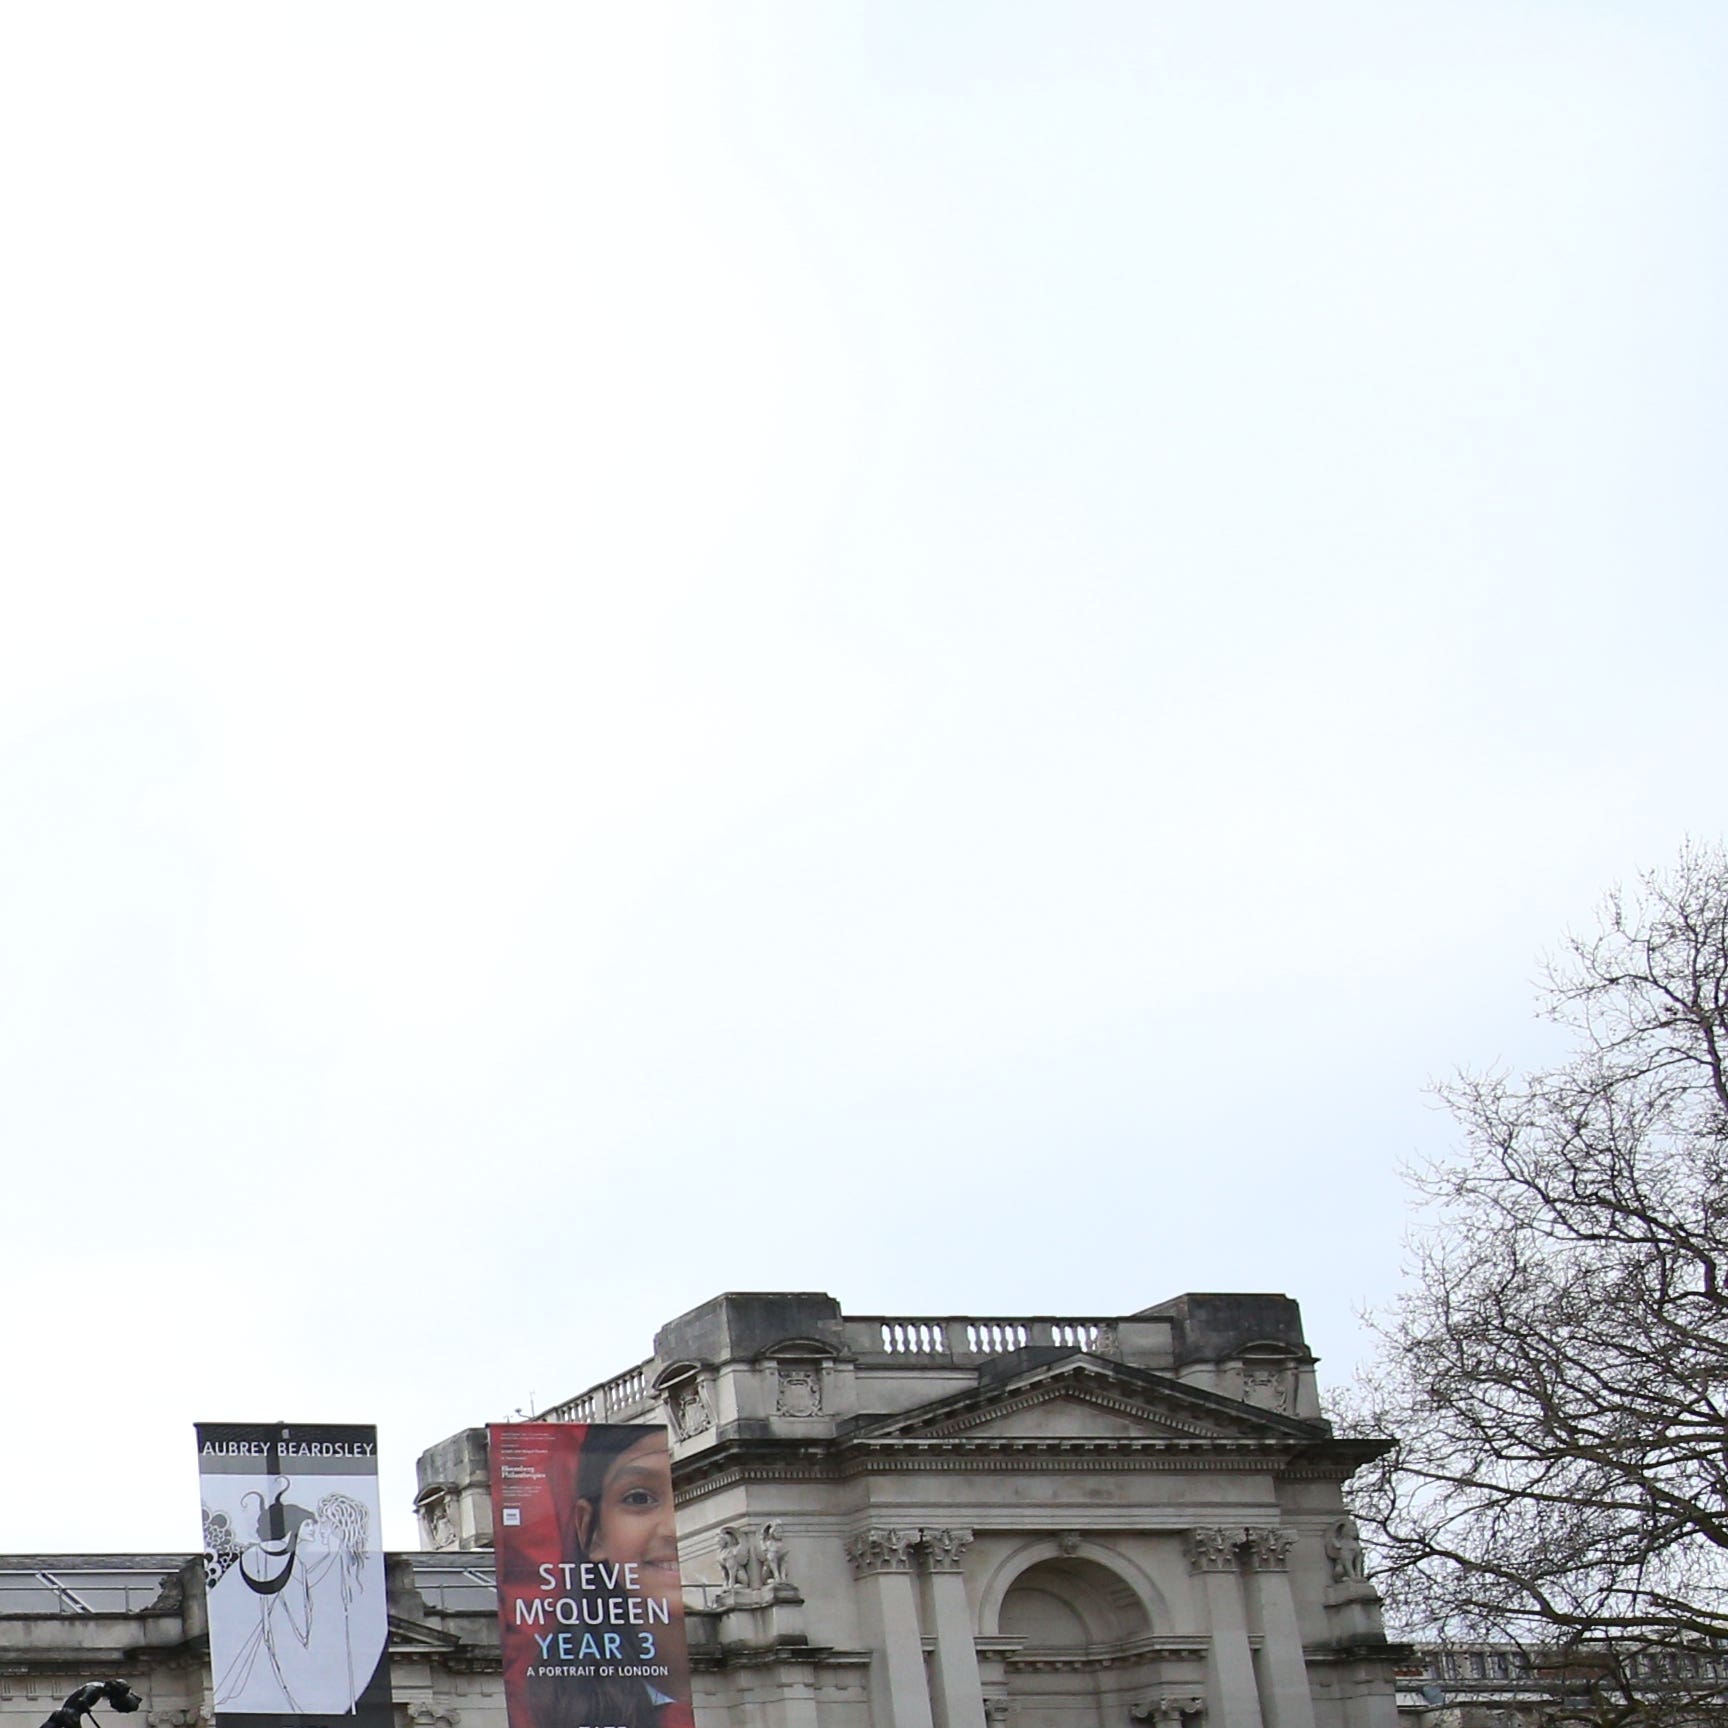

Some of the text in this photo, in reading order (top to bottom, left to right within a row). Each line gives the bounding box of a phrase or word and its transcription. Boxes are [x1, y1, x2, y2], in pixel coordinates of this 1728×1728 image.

[202, 1441, 374, 1458] AUBREY BEARDSLEY
[538, 1563, 641, 1591] STEVE
[515, 1597, 670, 1625] McQUEEN
[534, 1632, 656, 1660] YEAR 3
[526, 1666, 669, 1676] A PORTRAIT OF LONDON
